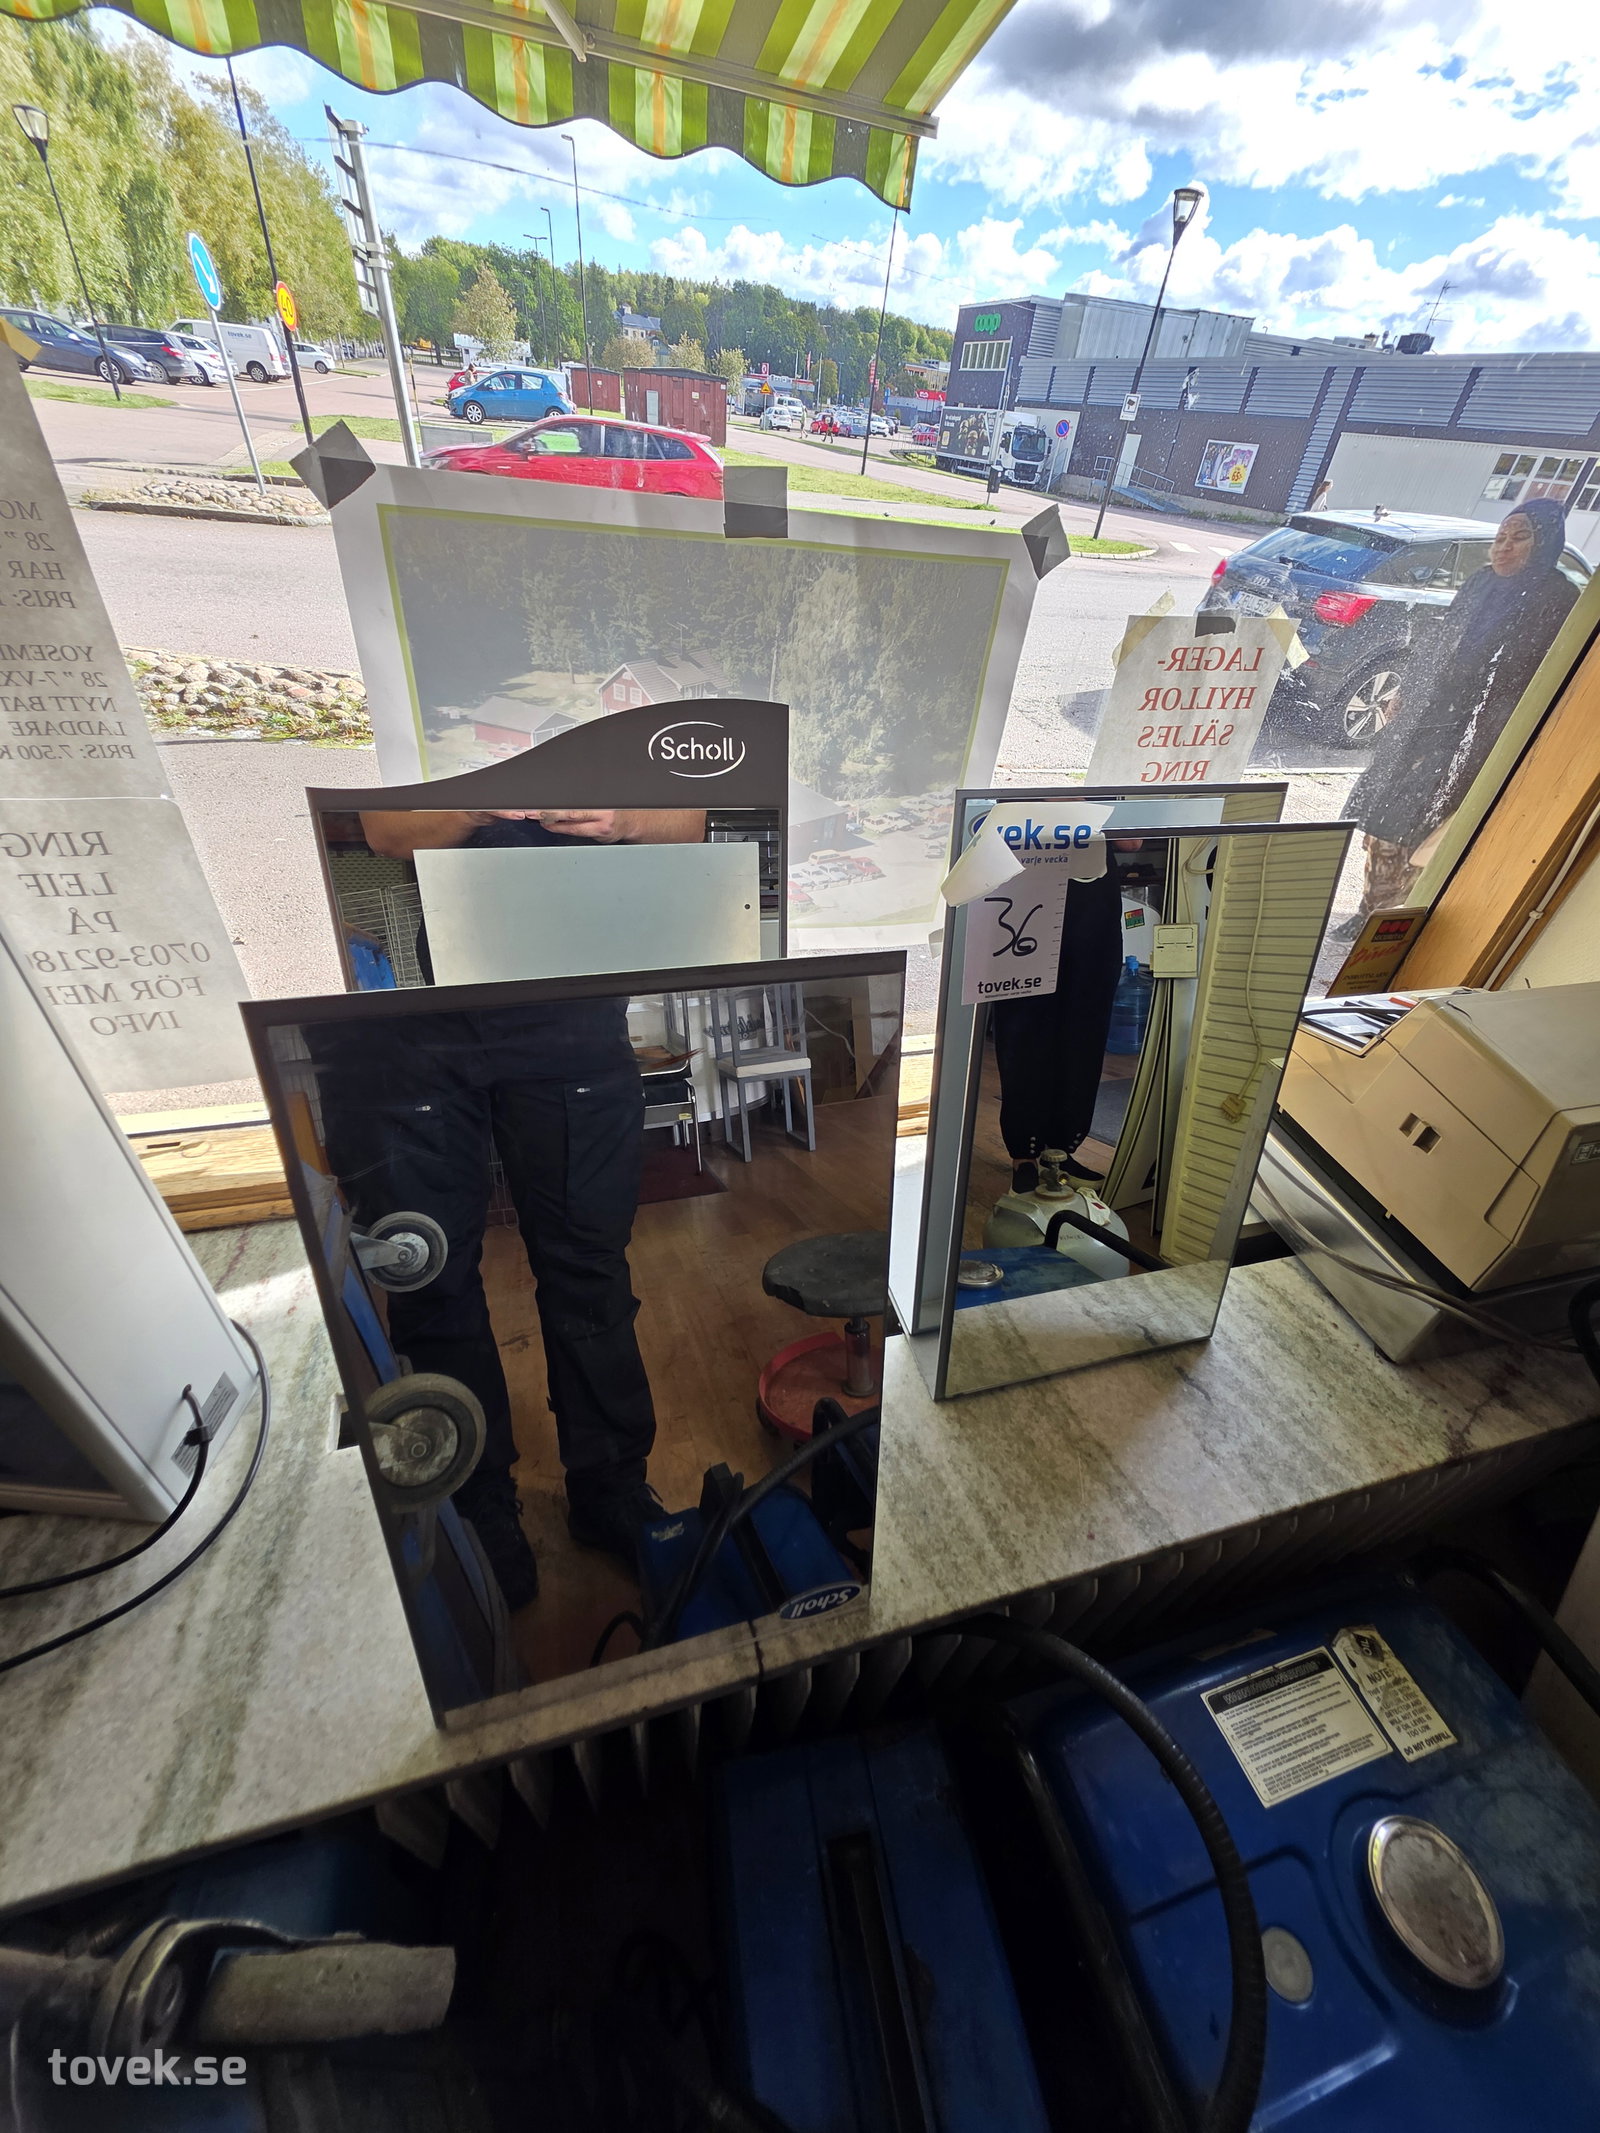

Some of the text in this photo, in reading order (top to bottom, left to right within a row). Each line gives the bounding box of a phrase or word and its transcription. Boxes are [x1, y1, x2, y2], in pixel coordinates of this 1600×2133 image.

[281, 294, 294, 318] 40
[974, 313, 1001, 335] coop
[660, 736, 735, 761] Scholl
[996, 819, 1092, 850] ek.se
[984, 896, 1043, 957] 36
[977, 975, 1042, 994] tovek.se
[790, 1588, 851, 1619] Scholl
[1359, 1637, 1373, 1656] OIL
[1403, 1731, 1451, 1756] DO NOT OVERFILL
[1407, 1724, 1432, 1739] TOO LOW
